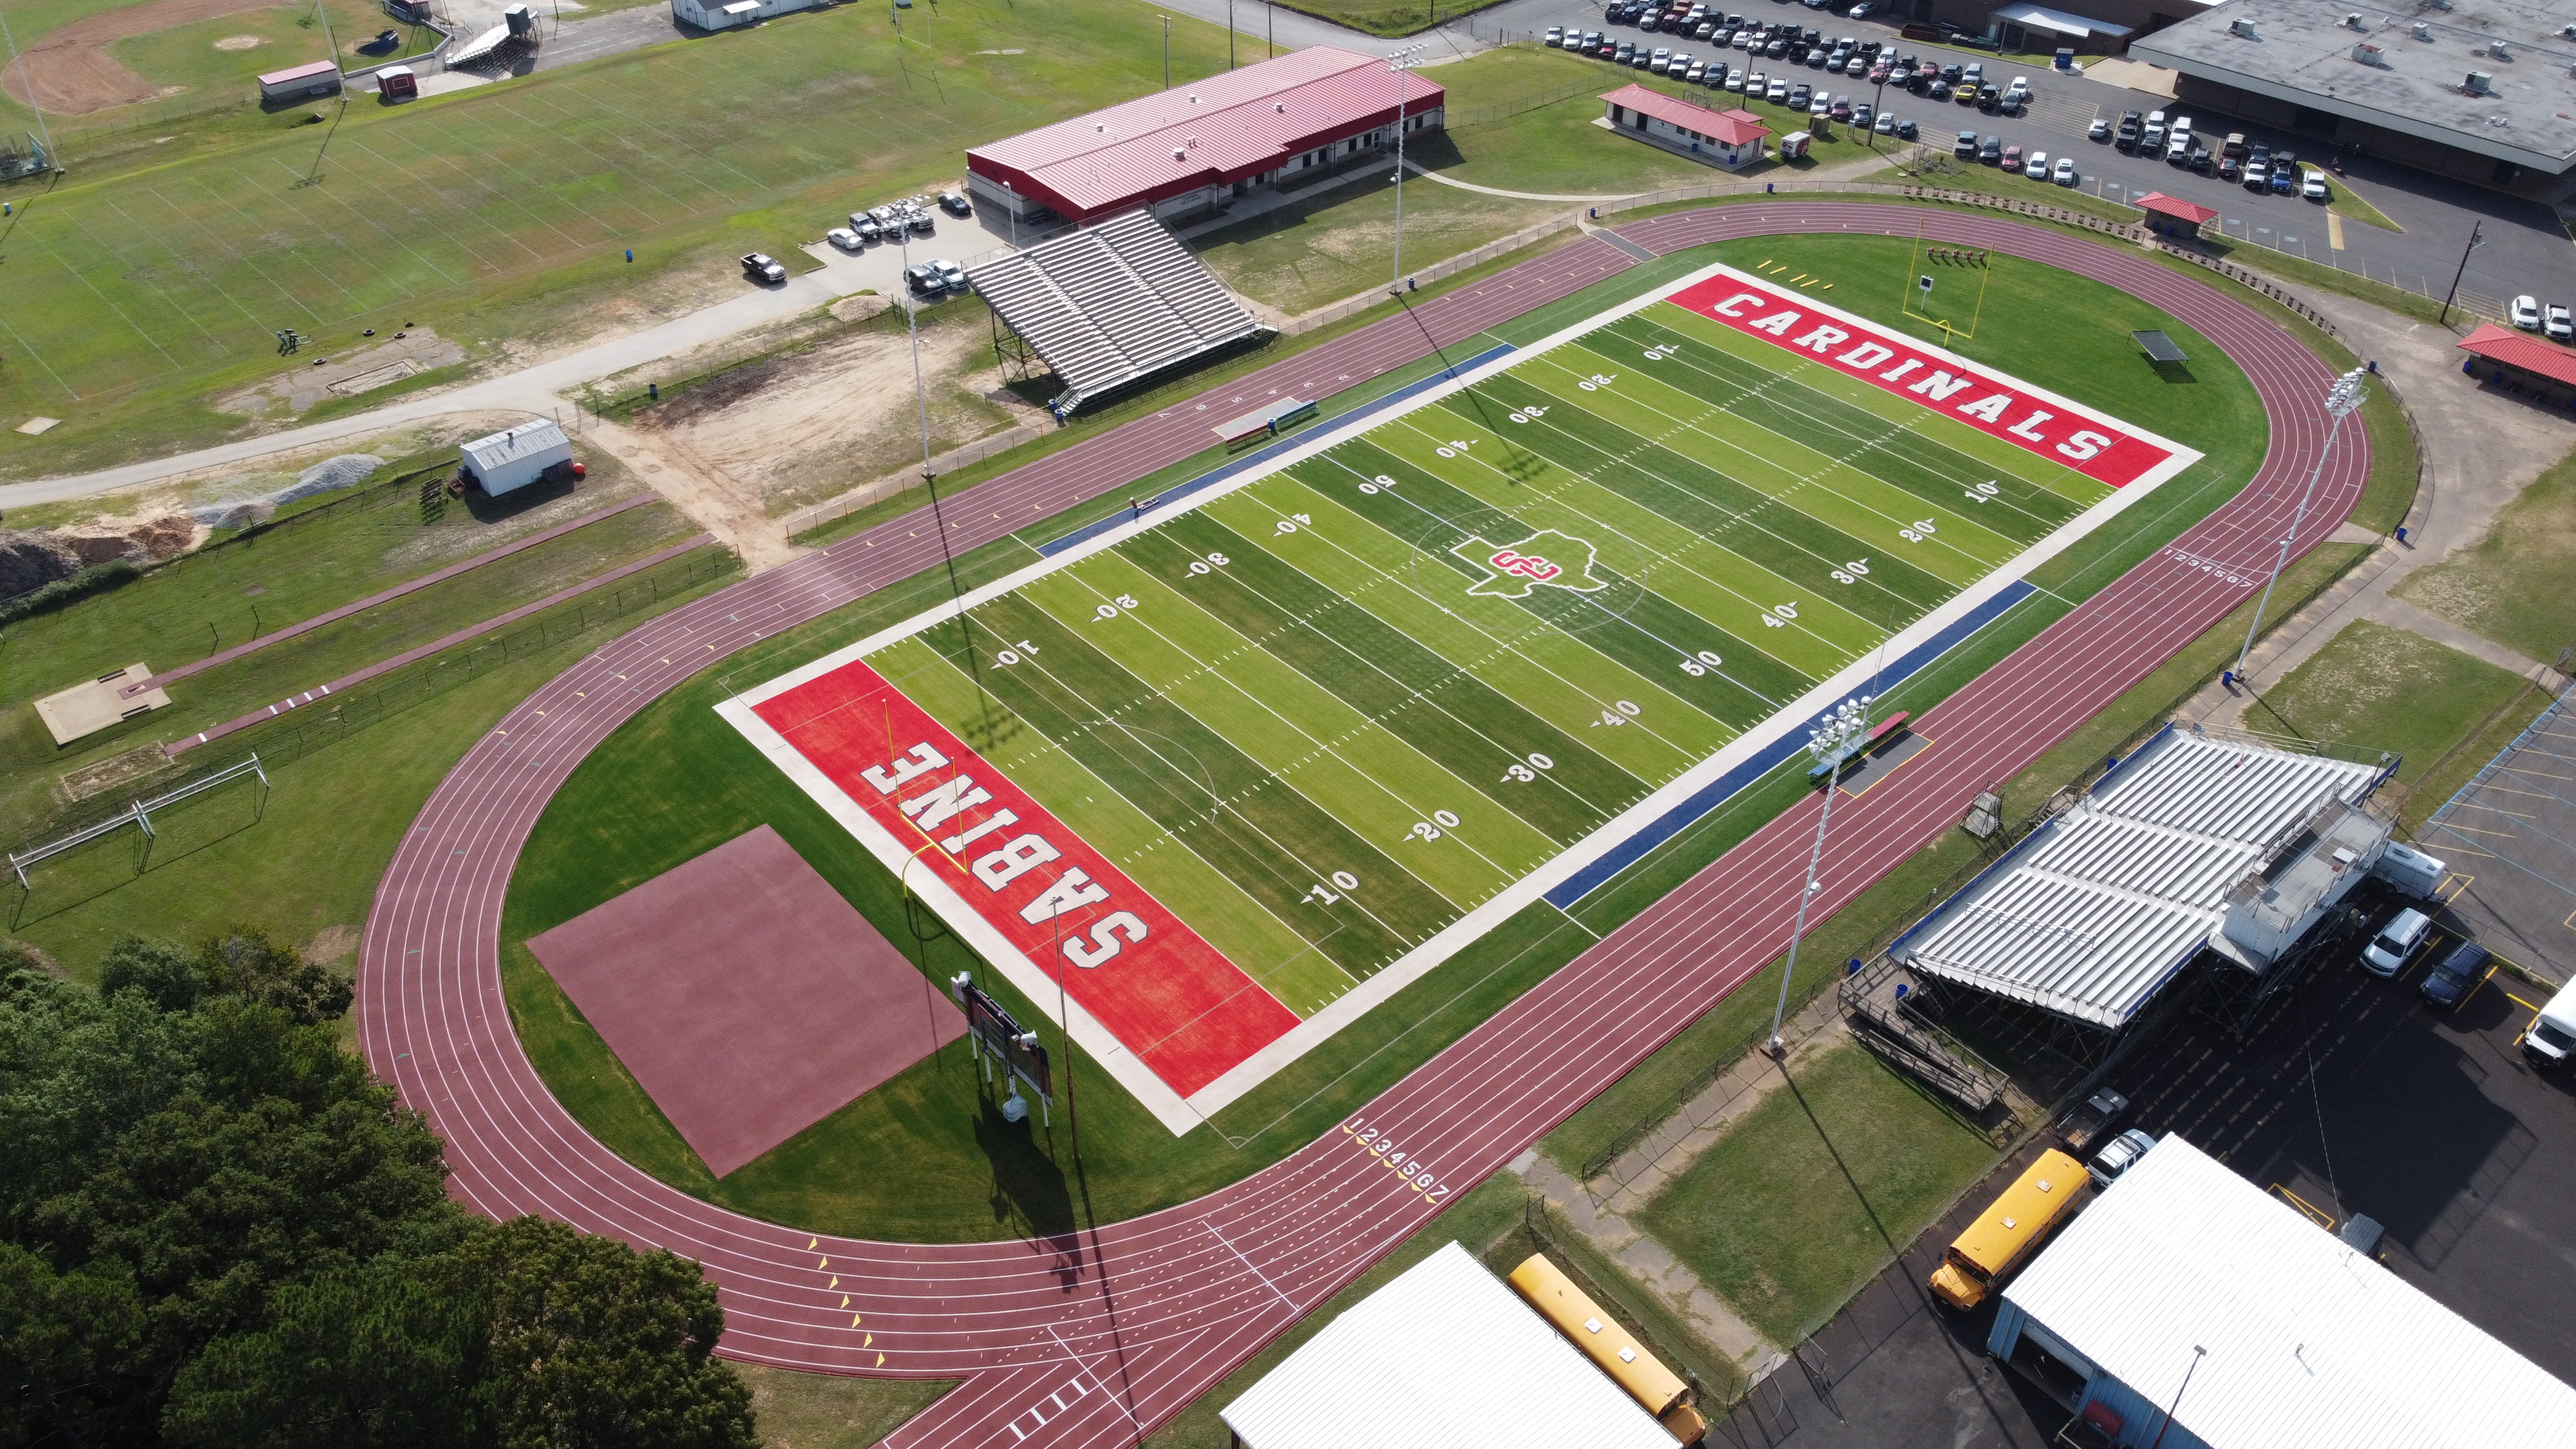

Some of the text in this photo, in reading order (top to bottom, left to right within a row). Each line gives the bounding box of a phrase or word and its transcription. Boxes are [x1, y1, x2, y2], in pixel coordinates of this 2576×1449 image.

[1643, 344, 1676, 361] 10
[1578, 374, 1612, 392] 20
[1713, 293, 2112, 461] CARDINALS
[1509, 406, 1544, 424] 30
[1435, 440, 1471, 458] 40
[1358, 475, 1396, 495] 50
[1964, 482, 2000, 504] 10
[1274, 513, 1312, 533] 40
[1899, 520, 1937, 543] 20
[1189, 553, 1230, 575] 30
[1830, 561, 1869, 585] 30
[1096, 594, 1139, 618] 20
[1761, 603, 1799, 629] 40
[997, 639, 1040, 666] 10
[1678, 650, 1723, 677] 50
[1600, 699, 1642, 727] 40
[1508, 752, 1555, 782] 30
[1413, 810, 1461, 842] 20
[860, 741, 1149, 969] SABINE
[1310, 871, 1359, 905] 10
[1349, 1118, 1450, 1197] 1 2 3 4 5 6 7
